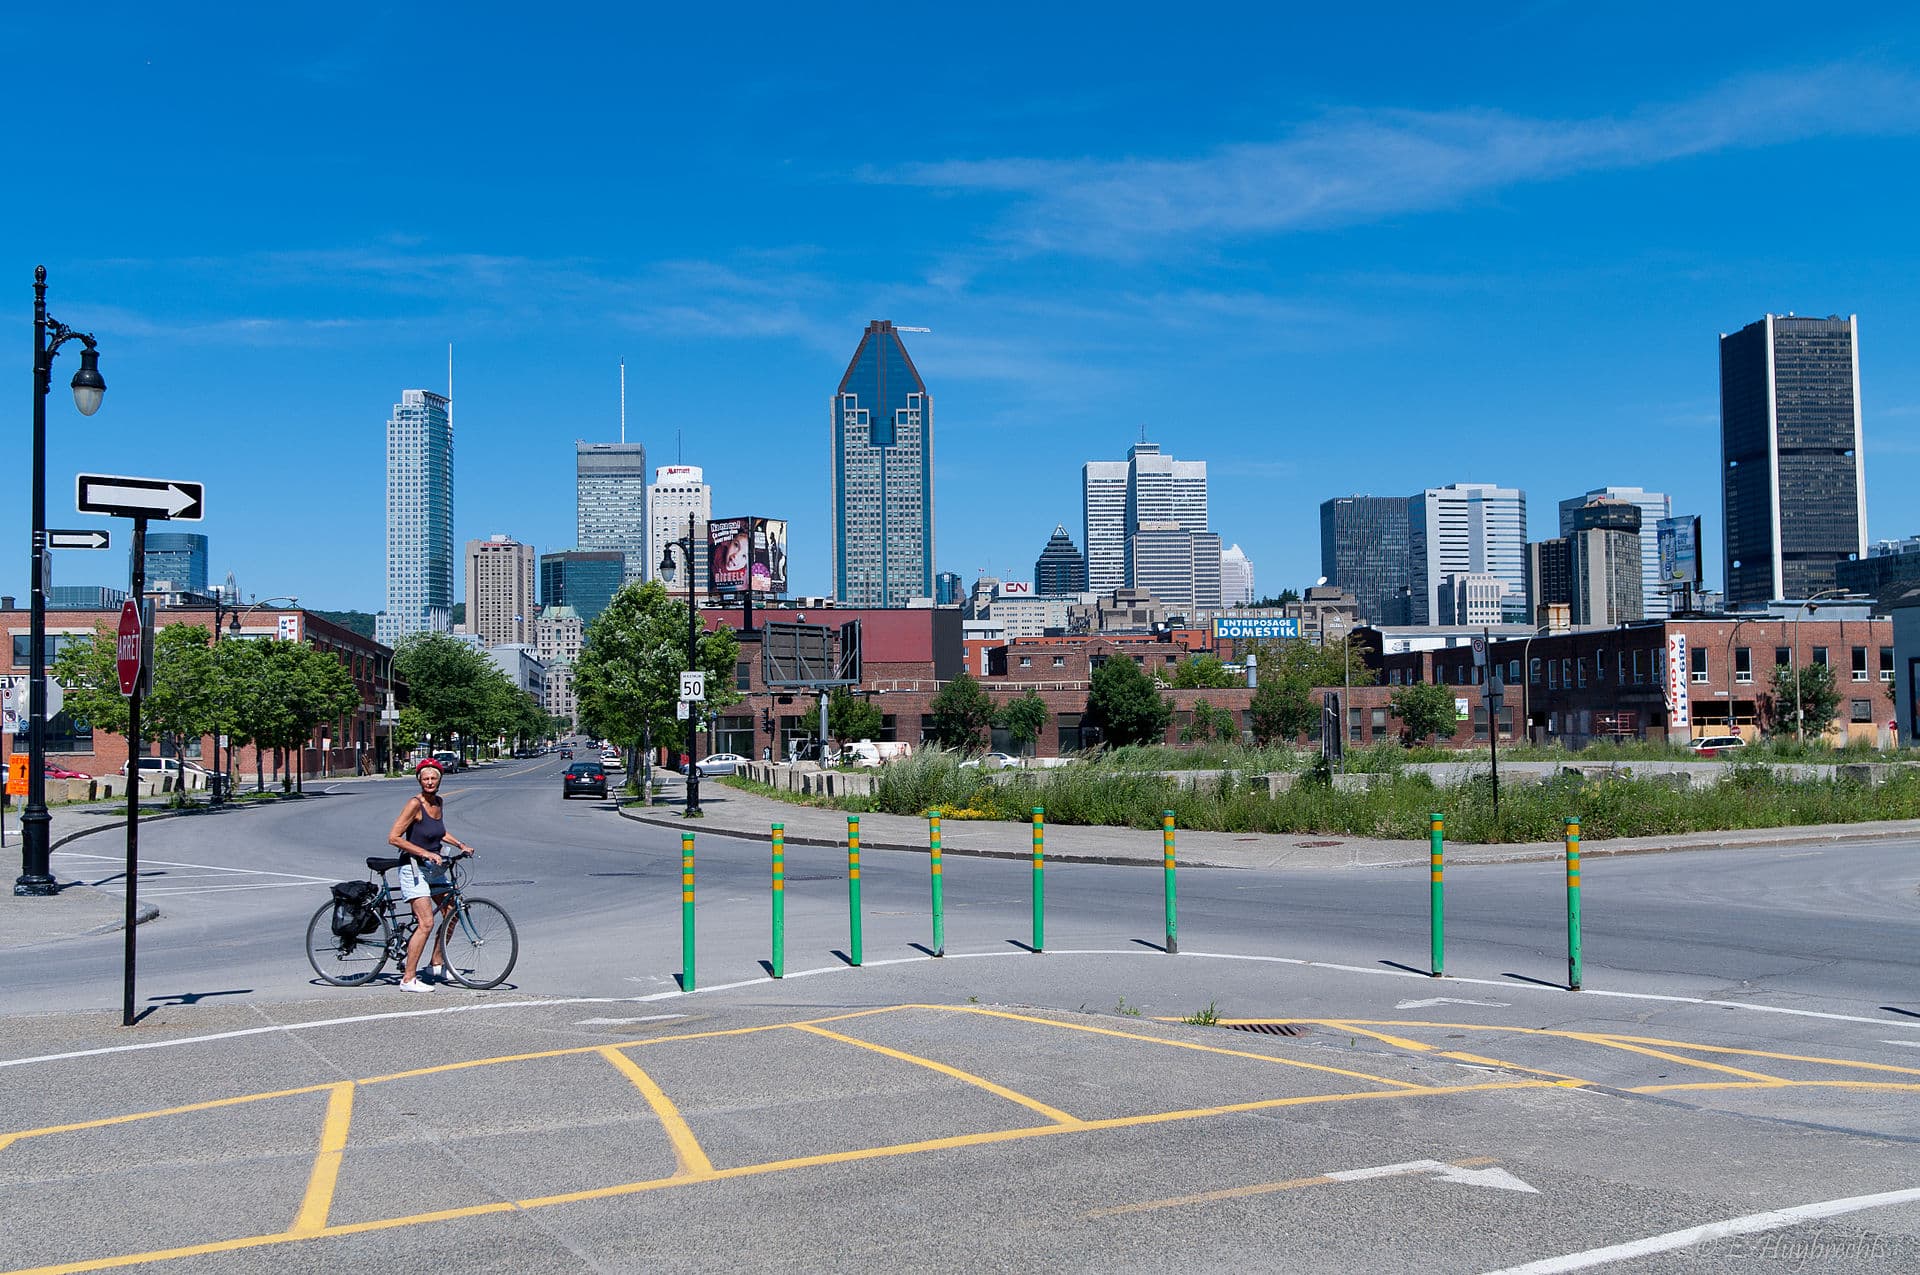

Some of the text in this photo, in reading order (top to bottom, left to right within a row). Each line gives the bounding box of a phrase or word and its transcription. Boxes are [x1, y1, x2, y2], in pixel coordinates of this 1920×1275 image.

[1005, 582, 1028, 592] CN
[1224, 619, 1291, 627] ENTREPOSAGE
[1219, 627, 1296, 637] DOMESTIK
[118, 630, 139, 660] ARRÊT
[1678, 637, 1687, 722] 989-7111
[684, 681, 701, 696] 50
